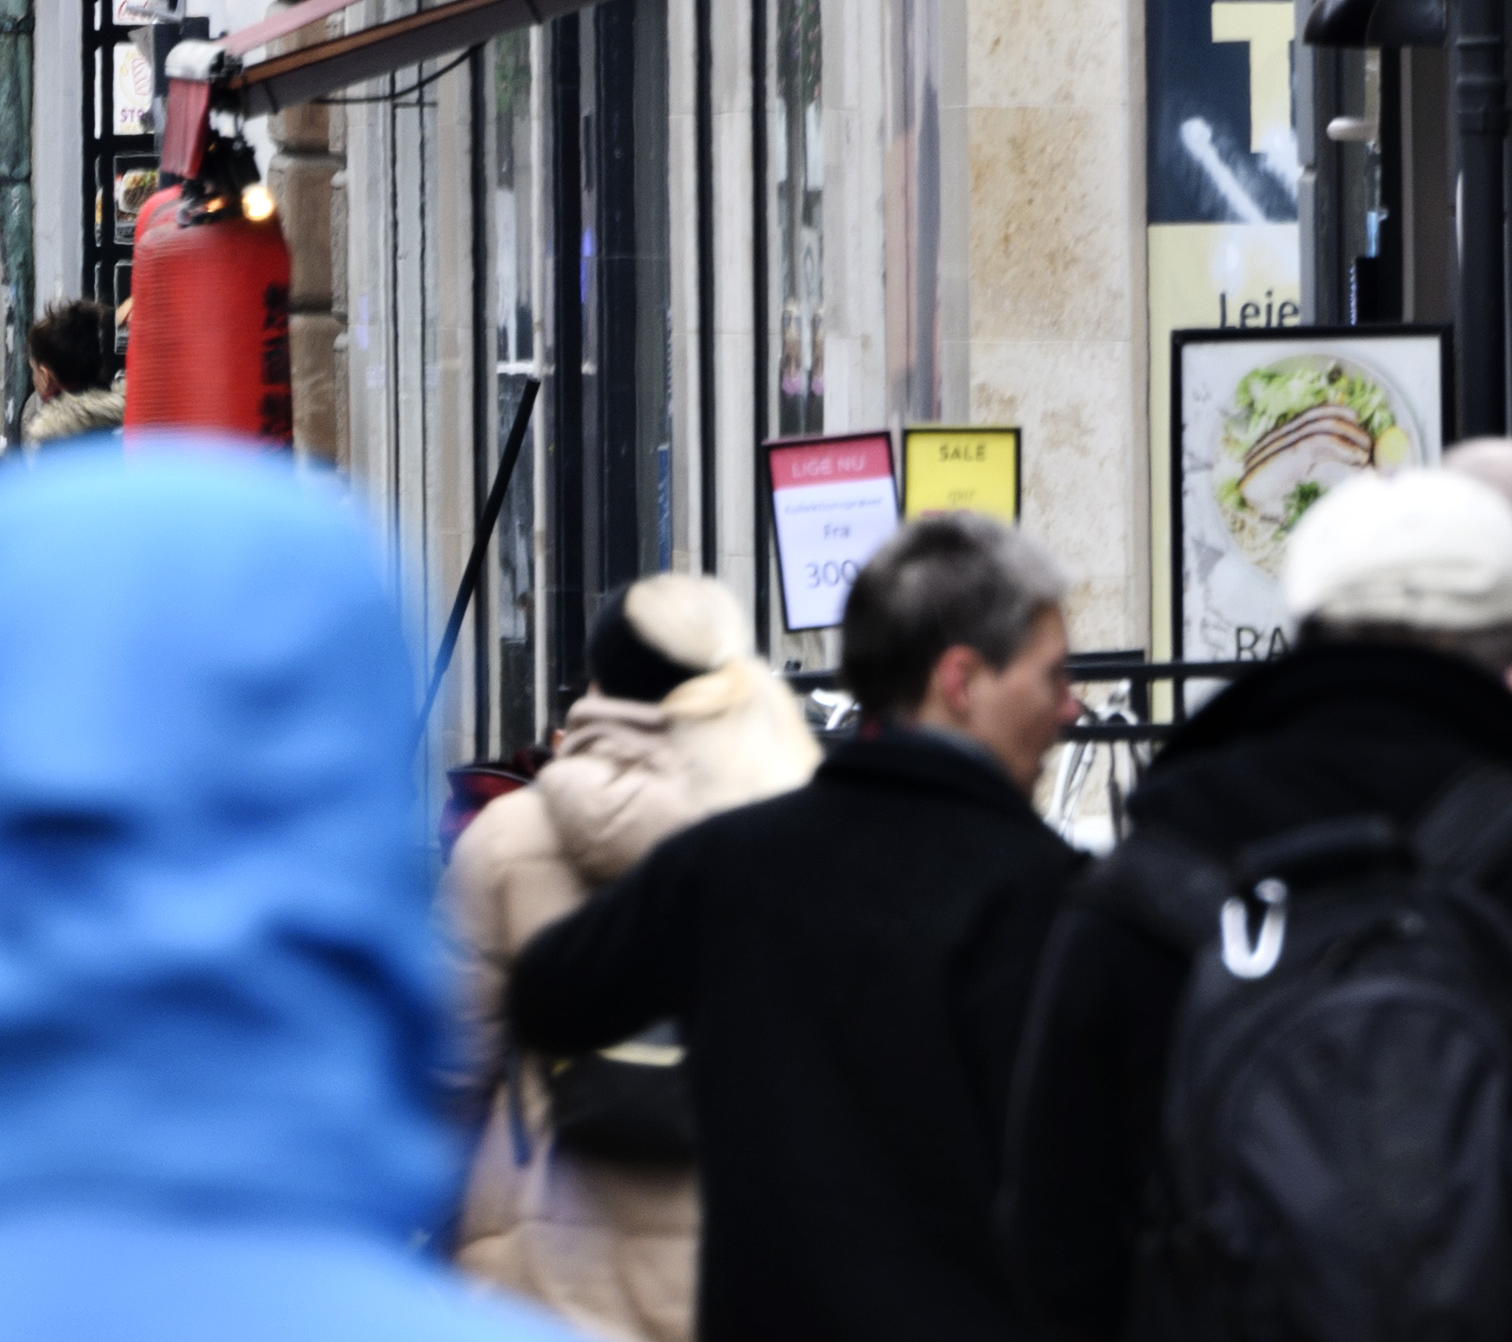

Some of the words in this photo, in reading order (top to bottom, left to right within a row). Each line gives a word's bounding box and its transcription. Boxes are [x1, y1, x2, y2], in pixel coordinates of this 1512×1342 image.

[938, 444, 987, 462] SALE
[790, 458, 832, 479] LIGE
[836, 455, 867, 474] NU
[823, 524, 851, 540] Fra
